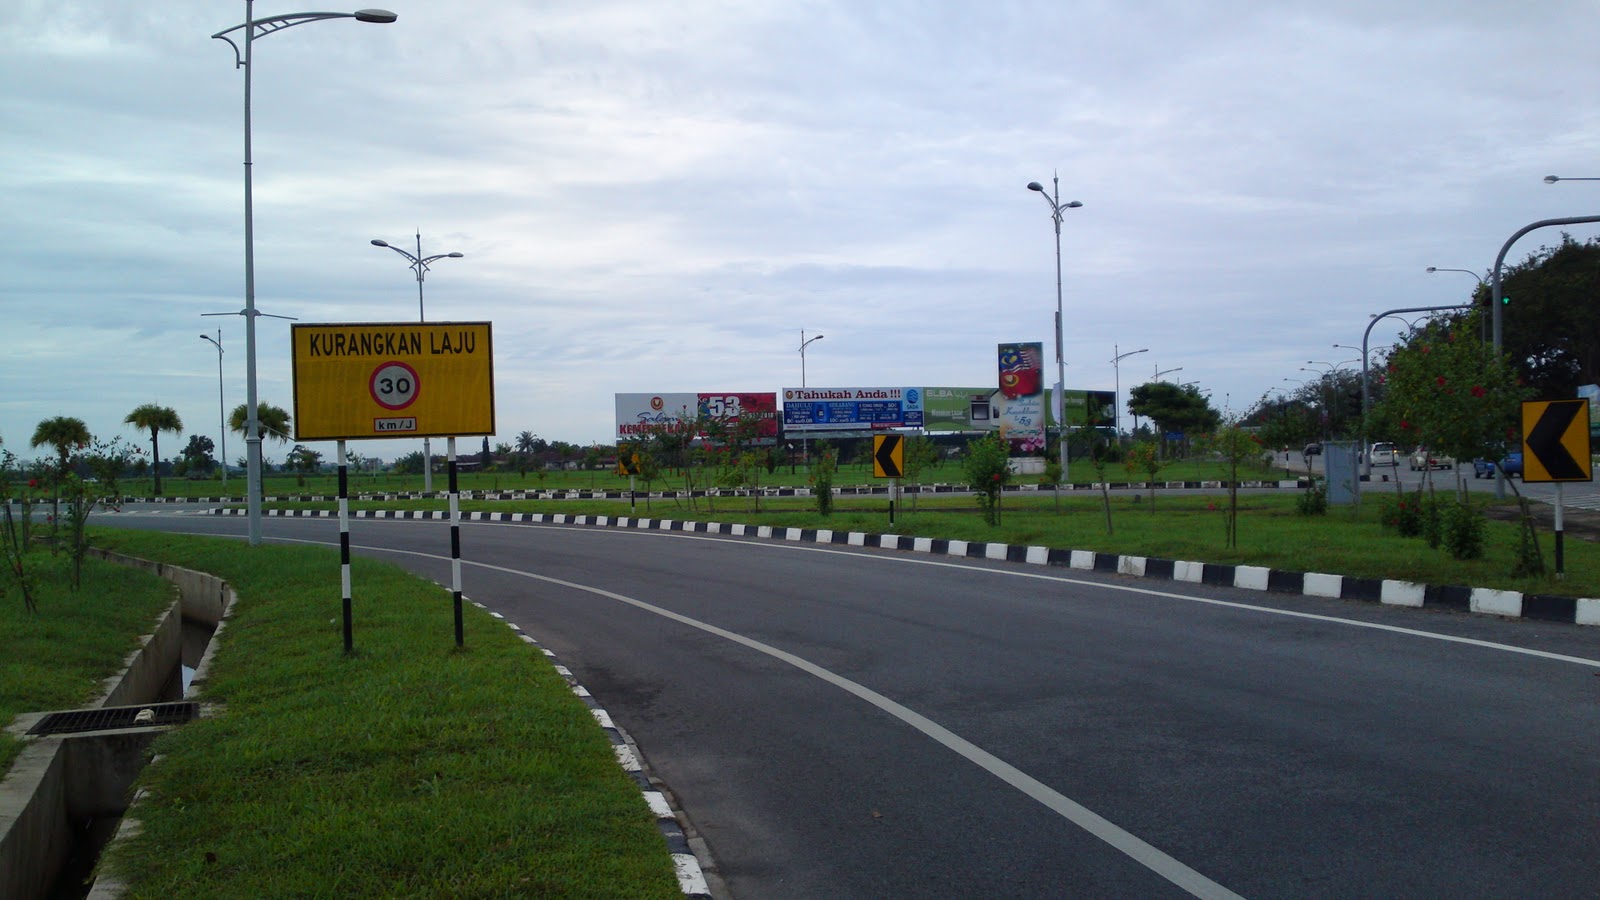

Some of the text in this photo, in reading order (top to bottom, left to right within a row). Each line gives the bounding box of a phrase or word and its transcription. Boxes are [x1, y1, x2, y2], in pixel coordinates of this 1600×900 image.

[309, 331, 476, 356] KURANGKAN LAJU
[379, 377, 411, 394] 30
[795, 389, 852, 399] Tahukah
[855, 389, 887, 399] Anda
[926, 390, 953, 398] ELBA
[709, 396, 741, 417] 53
[378, 419, 413, 430] km/J
